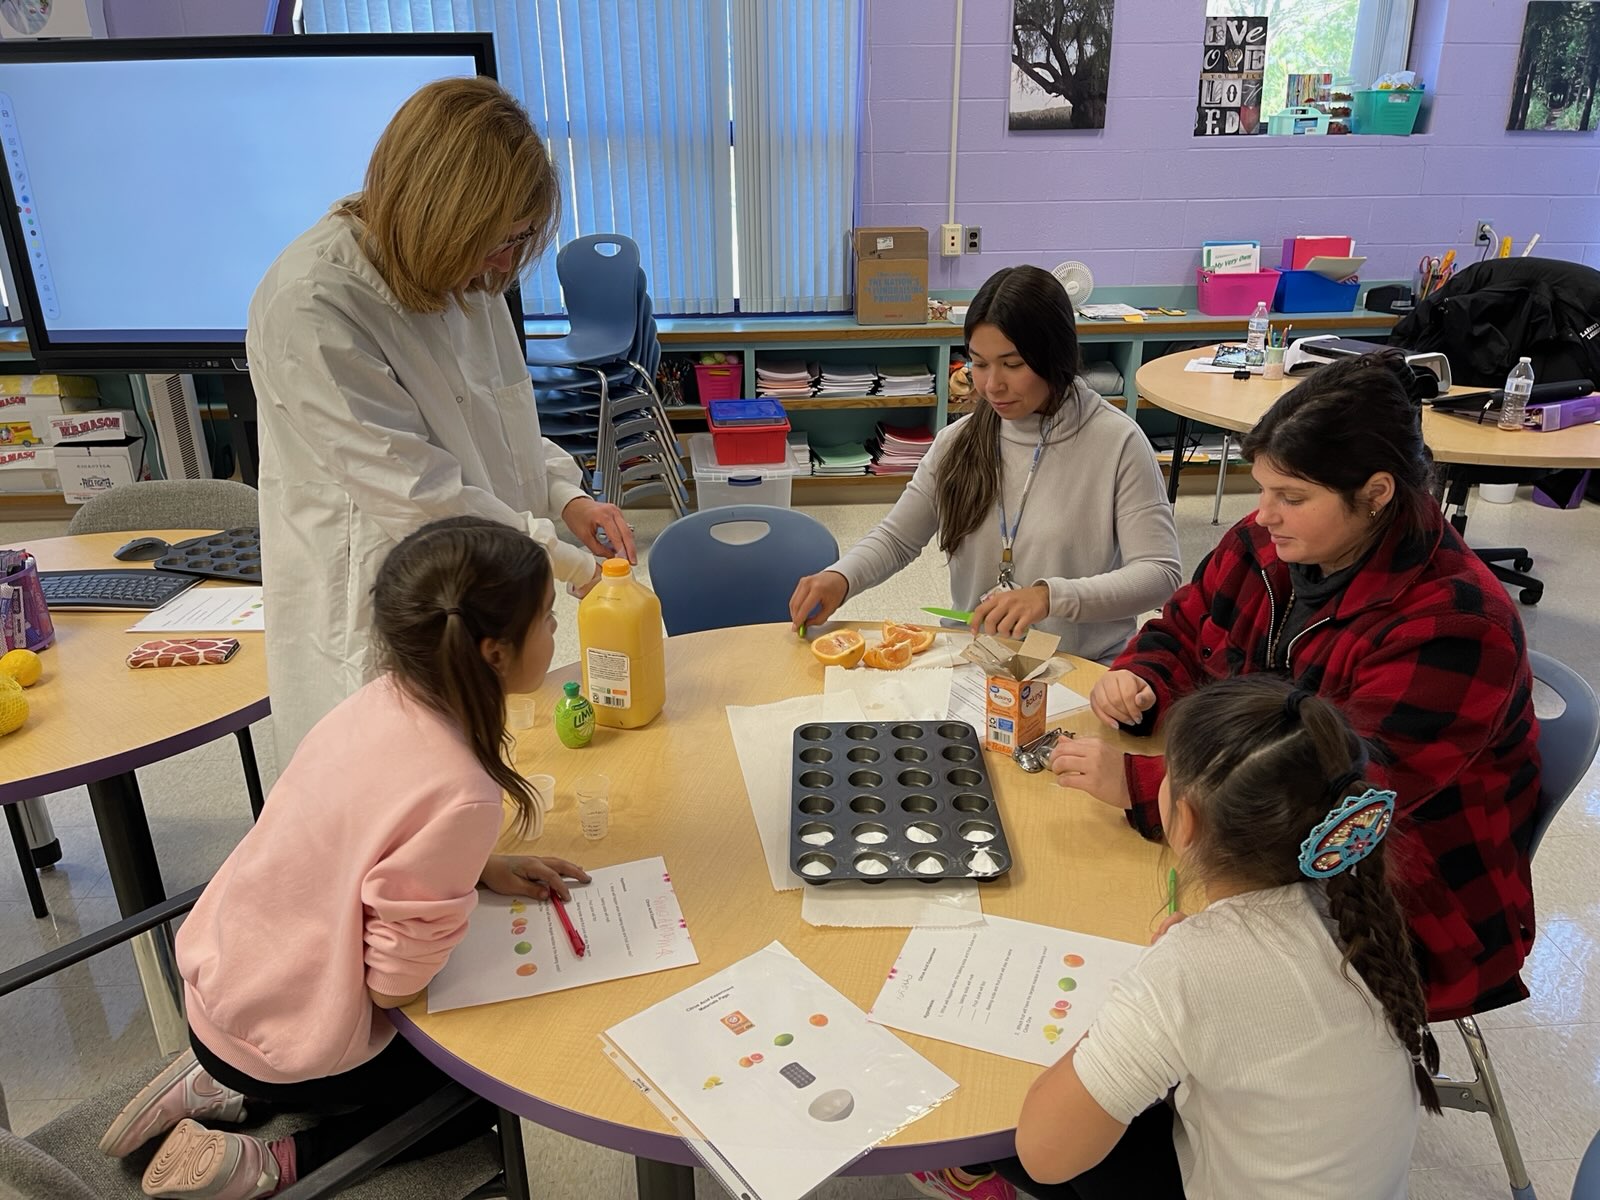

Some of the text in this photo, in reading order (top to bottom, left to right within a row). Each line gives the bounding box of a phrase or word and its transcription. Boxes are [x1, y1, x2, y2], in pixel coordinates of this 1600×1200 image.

[1224, 256, 1237, 268] Very
[574, 707, 593, 728] LIME
[686, 1004, 699, 1012] Citrus
[709, 986, 734, 999] Experiment
[698, 999, 718, 1011] Materials
